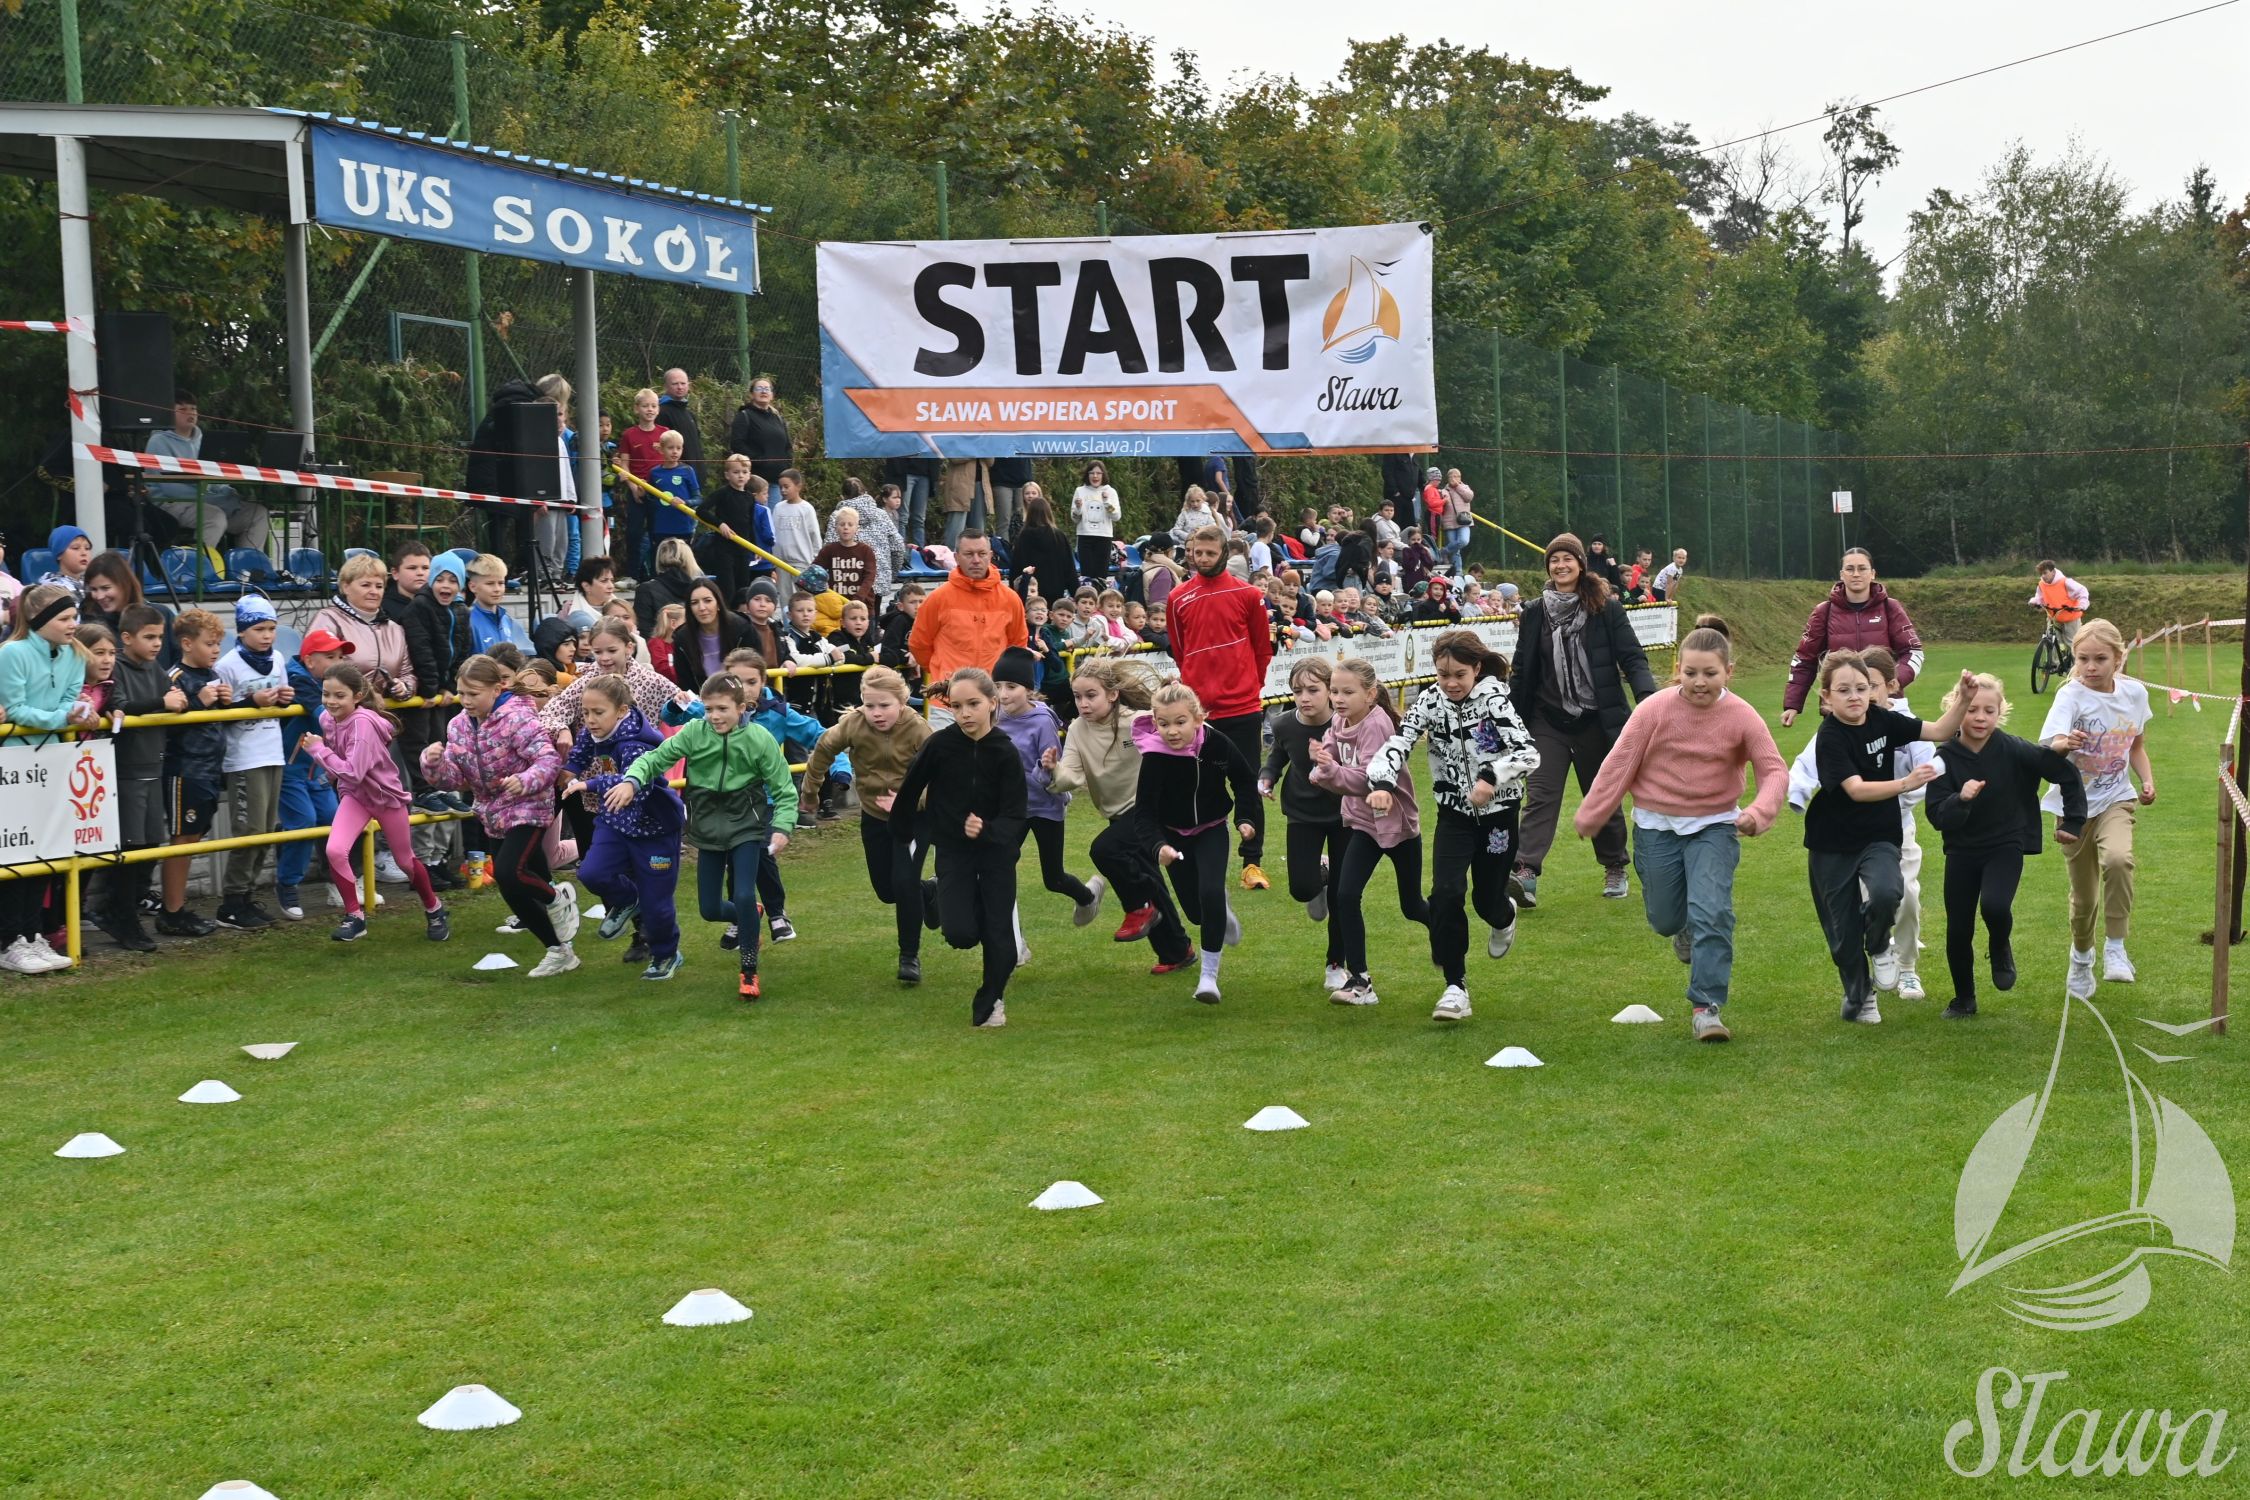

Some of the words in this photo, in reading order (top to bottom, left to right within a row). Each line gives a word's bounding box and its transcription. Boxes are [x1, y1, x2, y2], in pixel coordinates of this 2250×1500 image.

[338, 158, 454, 230] UKS
[493, 195, 738, 282] SOKÓŁ
[913, 253, 1311, 378] START
[916, 402, 992, 422] SŁAWA
[998, 400, 1099, 421] WSPIERA
[1104, 399, 1178, 421] SPORT
[1032, 437, 1152, 457] www.slawa.pl
[832, 556, 865, 569] little
[832, 569, 860, 582] Bro
[1876, 753, 1884, 768] 9
[26, 763, 48, 788] się
[75, 826, 103, 845] PZPN
